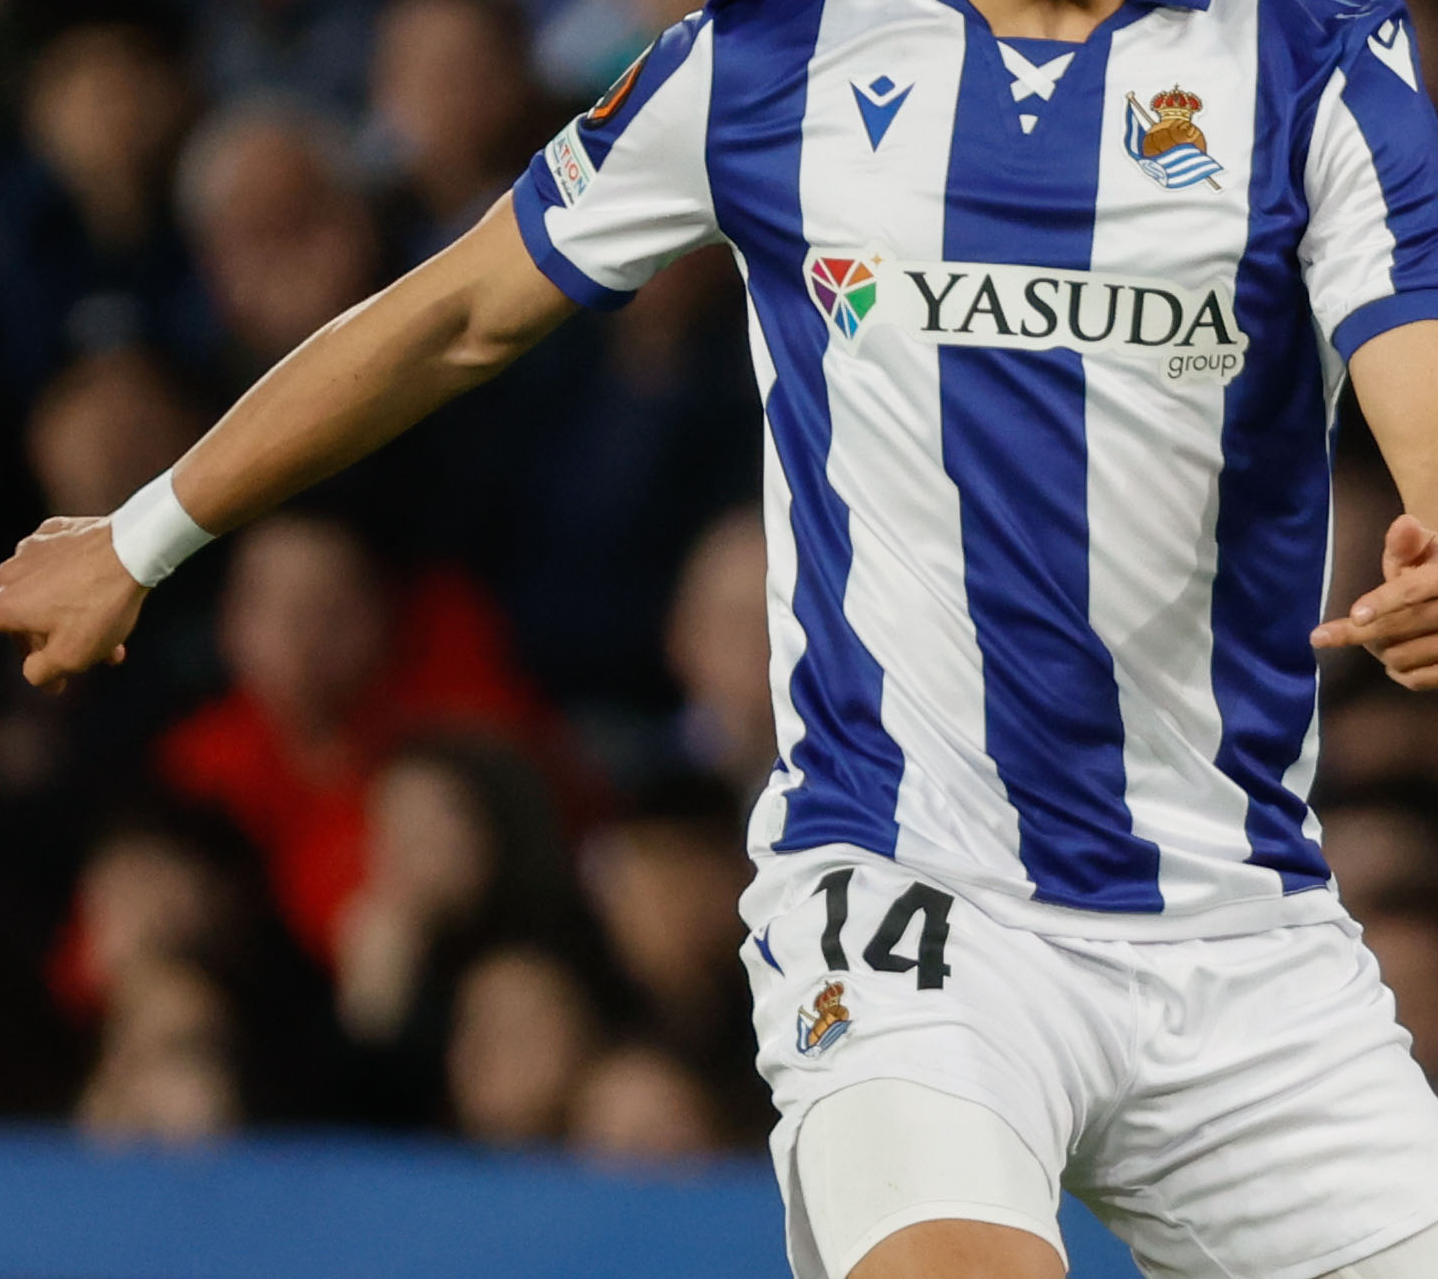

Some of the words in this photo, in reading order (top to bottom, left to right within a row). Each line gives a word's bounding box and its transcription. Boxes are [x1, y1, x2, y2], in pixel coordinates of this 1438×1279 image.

[903, 270, 1239, 347] YASUDA
[1166, 351, 1237, 378] group
[810, 867, 955, 990] 14
